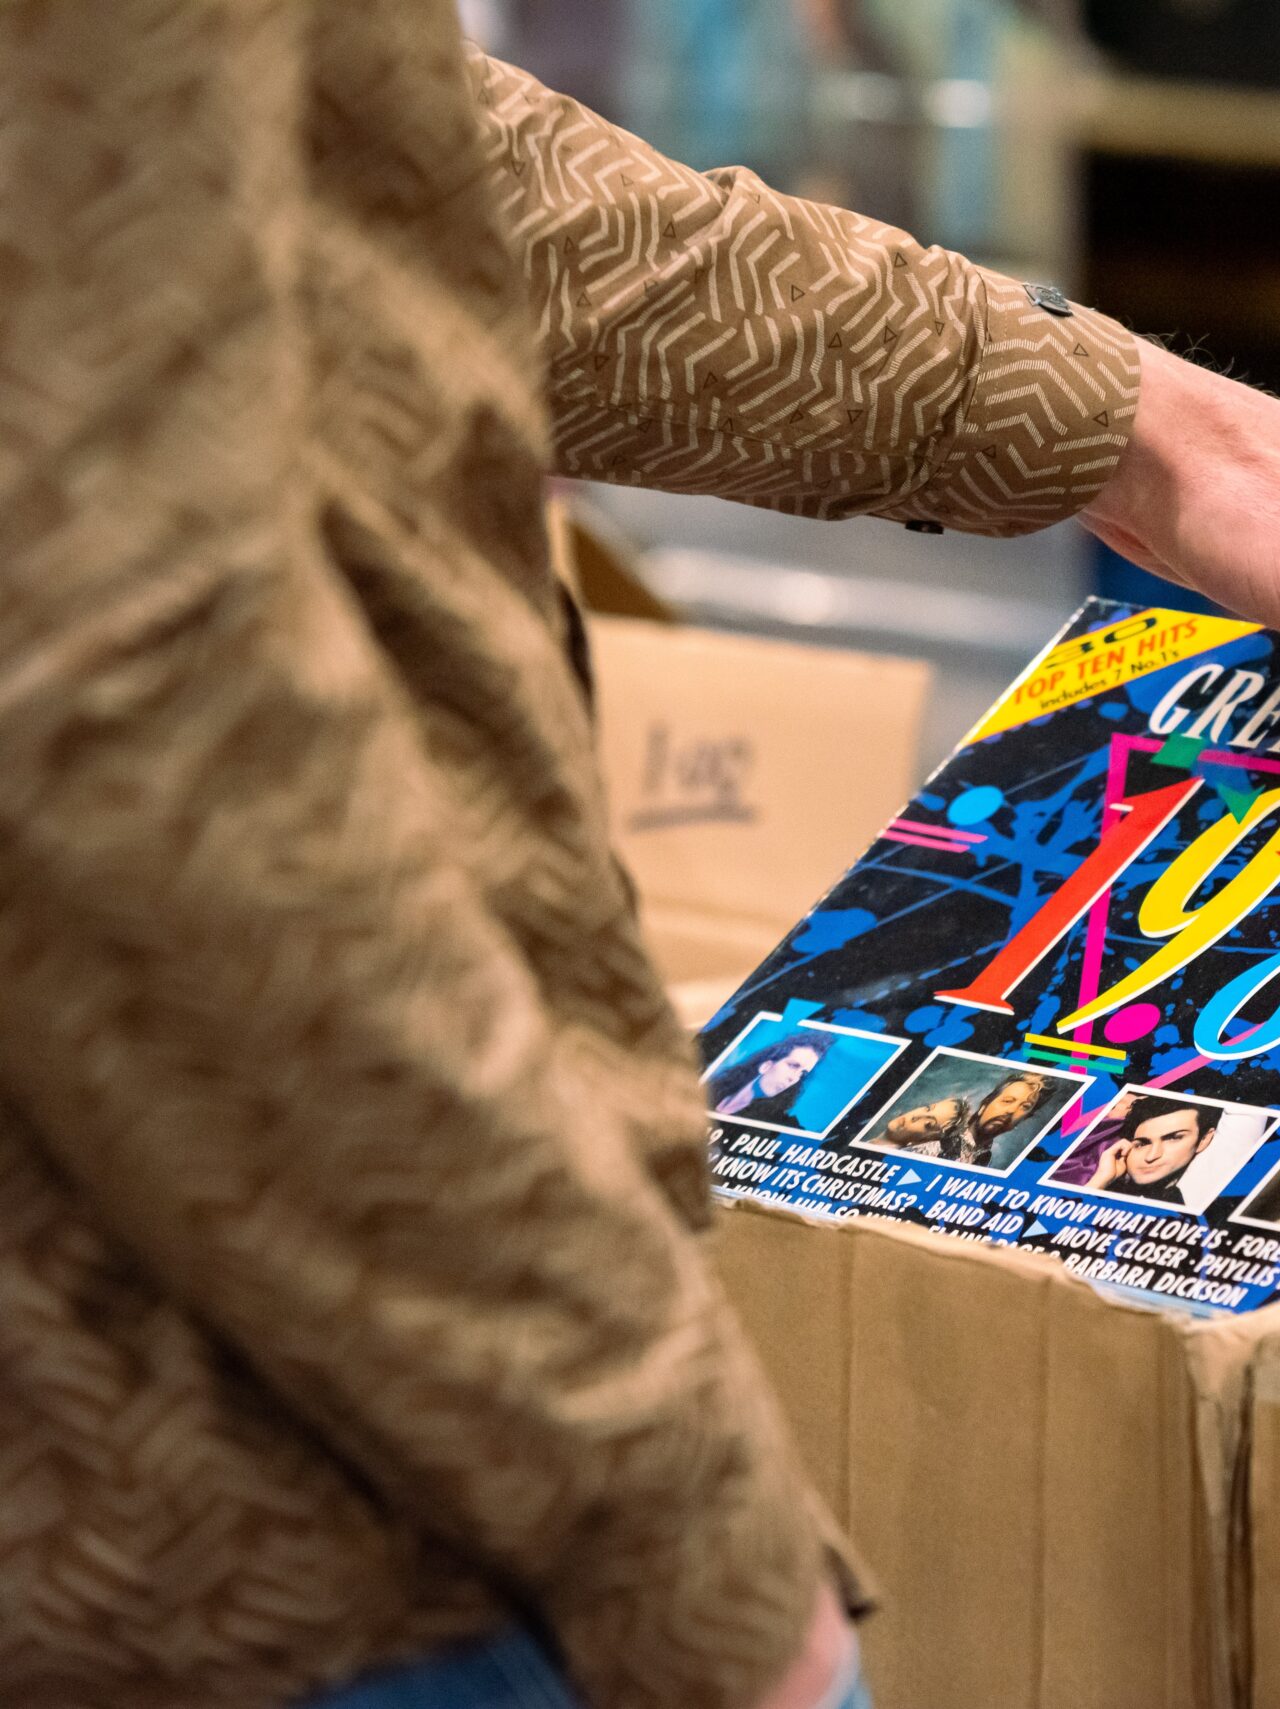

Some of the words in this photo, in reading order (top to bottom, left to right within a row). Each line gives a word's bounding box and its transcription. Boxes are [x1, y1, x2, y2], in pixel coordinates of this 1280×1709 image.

[1013, 670, 1064, 704] TOP
[1077, 647, 1124, 679] TEN
[1137, 617, 1198, 656] HITS
[1041, 678, 1107, 709] includes
[712, 1155, 779, 1184] KNOW
[770, 1168, 806, 1190] ITS
[801, 1174, 917, 1213] CHRISTMAS?
[925, 1200, 985, 1227] BAND
[981, 1212, 1023, 1234] AID
[1051, 1225, 1116, 1254] MOVE
[1115, 1238, 1188, 1268] CLOSER
[1194, 1253, 1280, 1287] PHYLLIS
[729, 1133, 782, 1160] PAUL
[780, 1143, 901, 1183] HARDCASTLE
[925, 1174, 942, 1192] I
[941, 1177, 1004, 1204] WANT
[1000, 1187, 1030, 1209] TO
[1028, 1194, 1093, 1222] KNOW
[1090, 1206, 1152, 1238] WHAT
[1149, 1218, 1207, 1246] LOVE
[1202, 1228, 1228, 1249] IS
[1064, 1254, 1154, 1289] BARBARA
[1155, 1272, 1249, 1308] DICKSON
